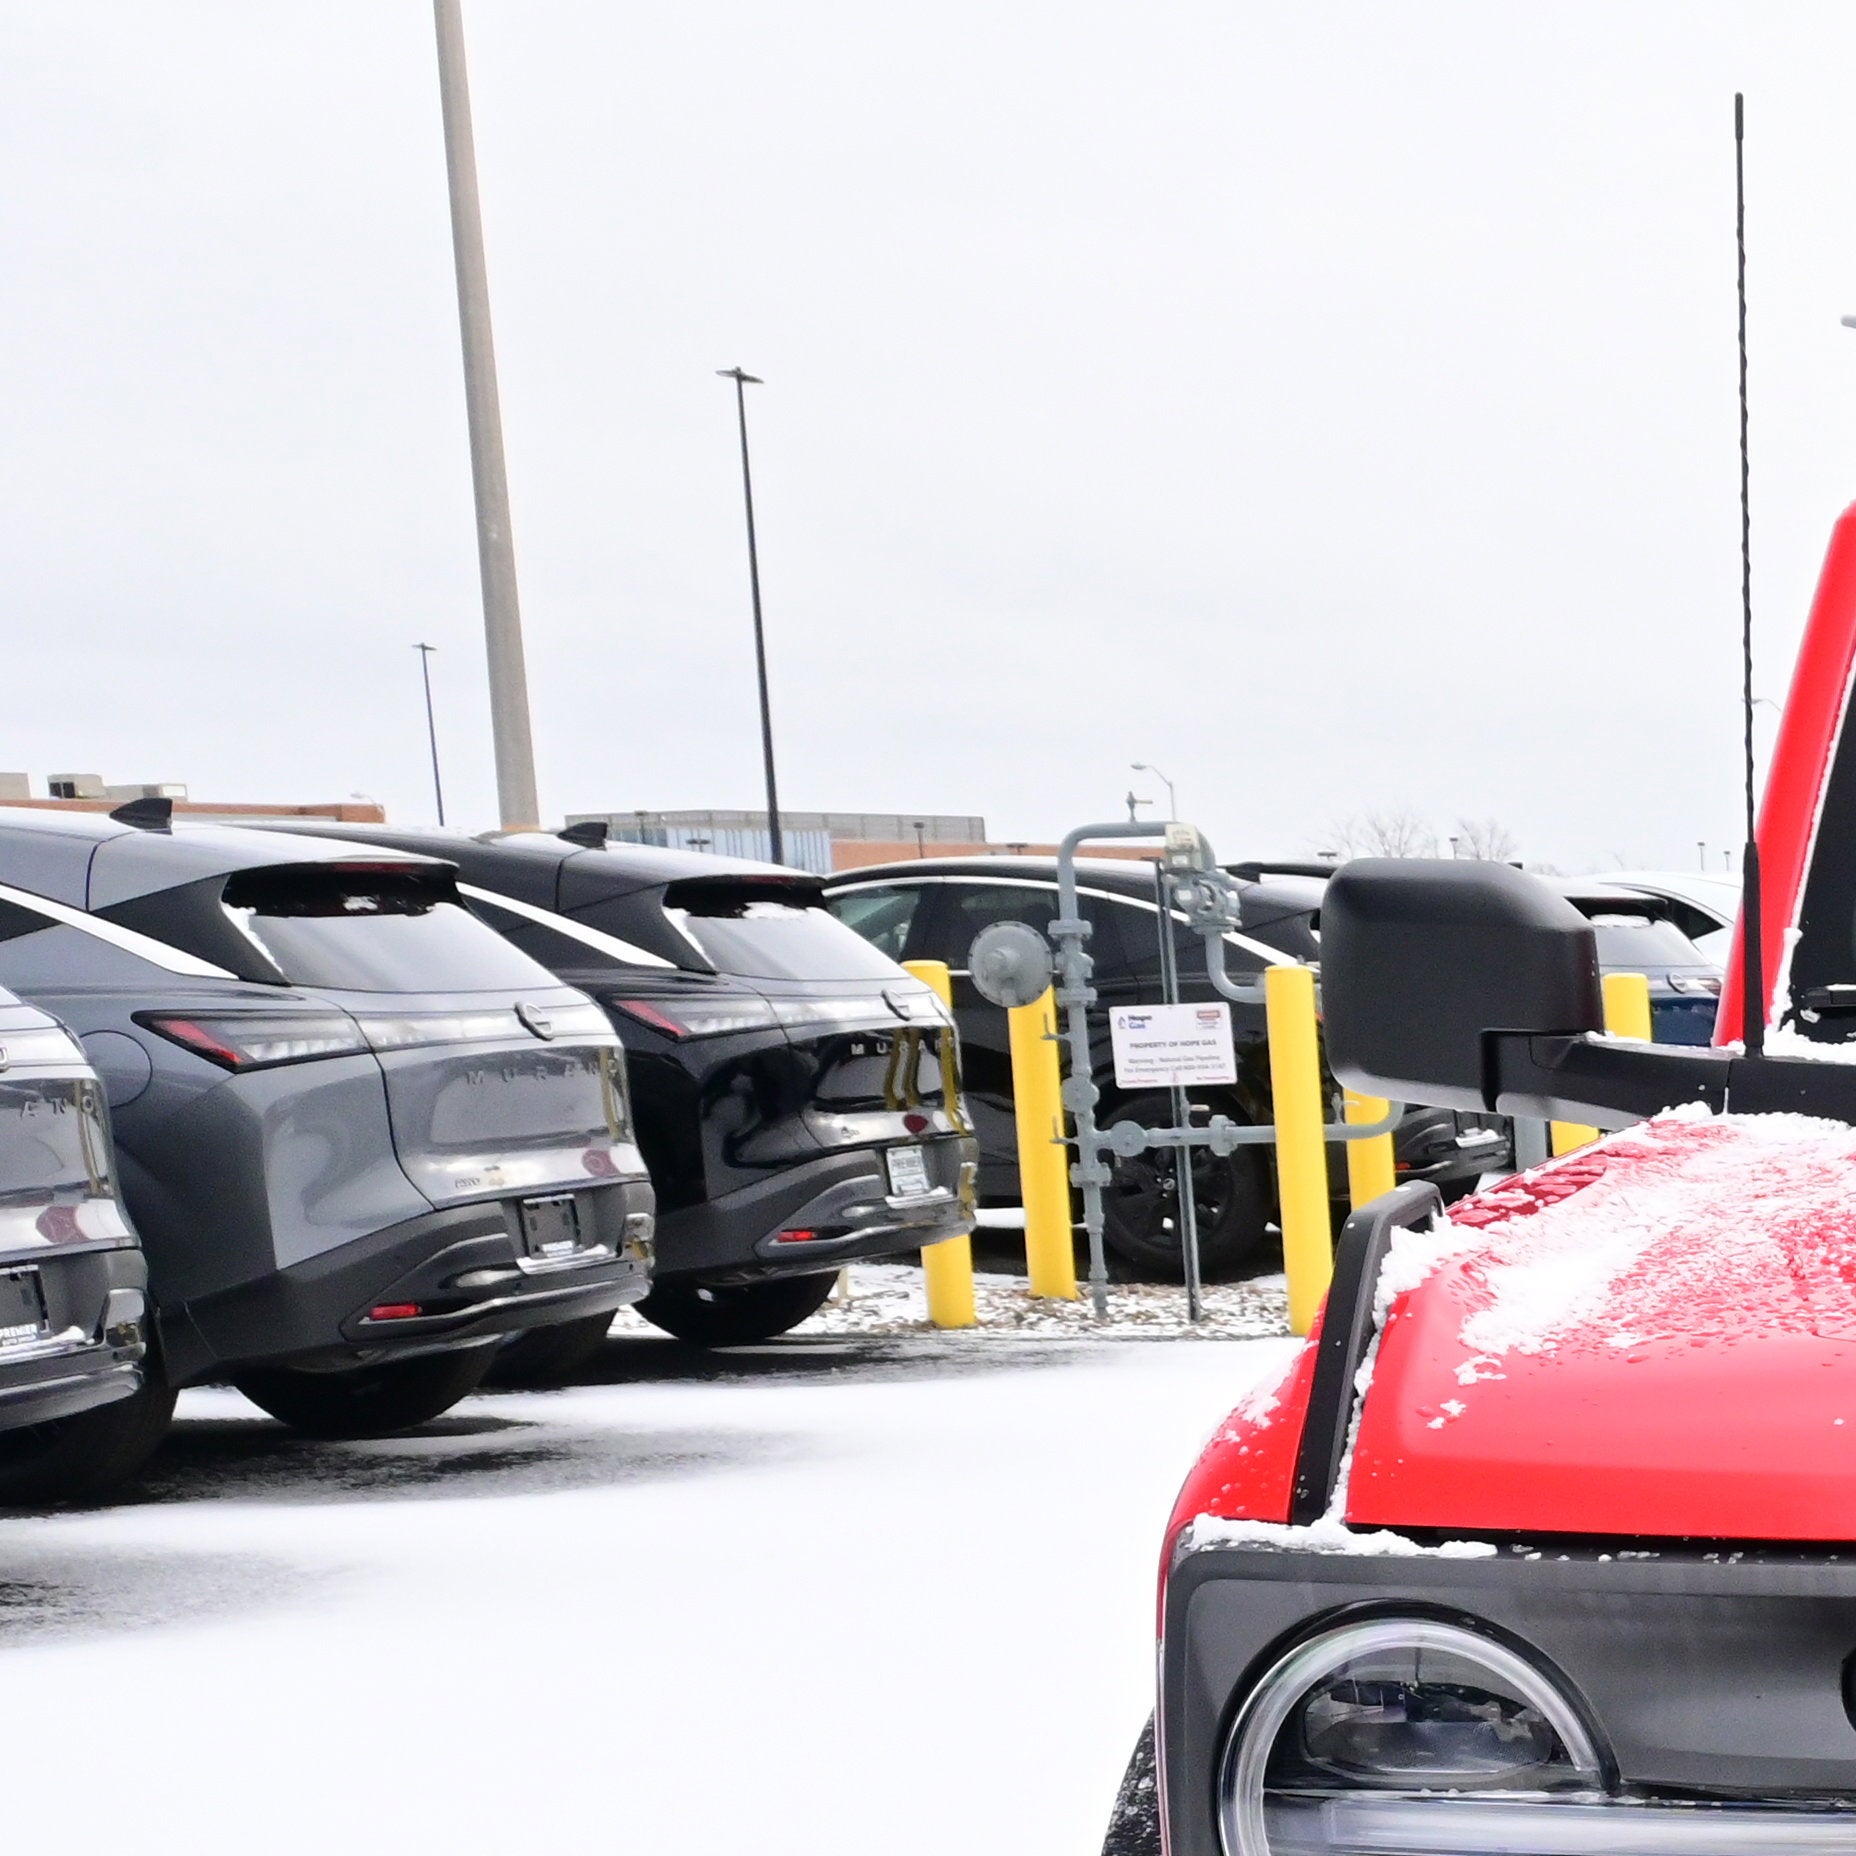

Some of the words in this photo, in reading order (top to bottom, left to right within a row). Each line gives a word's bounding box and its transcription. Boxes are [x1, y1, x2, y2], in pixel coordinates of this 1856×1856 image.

[1128, 1014, 1152, 1022] Hope
[1129, 1022, 1146, 1030] Gas
[19, 1095, 96, 1118] ANO
